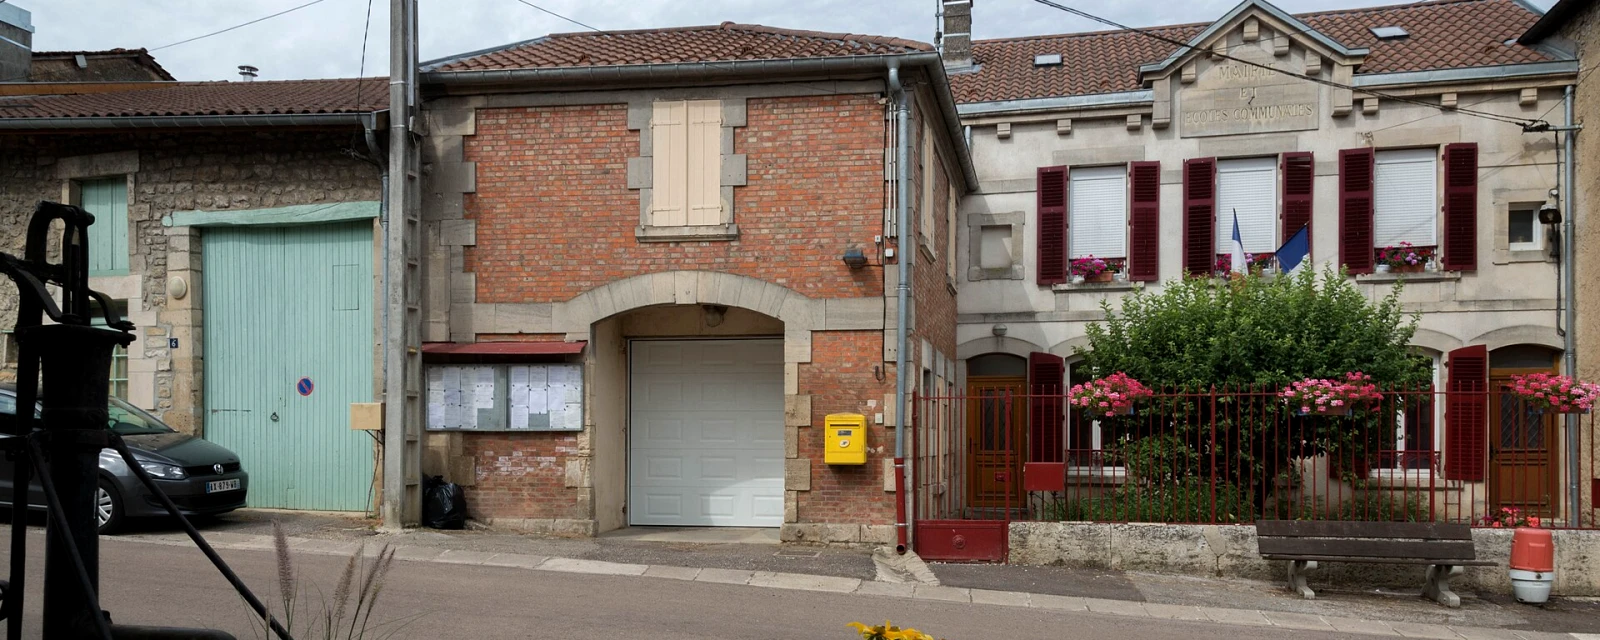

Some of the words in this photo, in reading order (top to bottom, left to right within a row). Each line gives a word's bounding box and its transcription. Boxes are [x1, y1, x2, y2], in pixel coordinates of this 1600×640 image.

[1219, 62, 1277, 80] MAIRIE
[1240, 87, 1257, 99] ET
[1185, 109, 1229, 124] ECOLES
[1233, 104, 1313, 121] COMMUNALES
